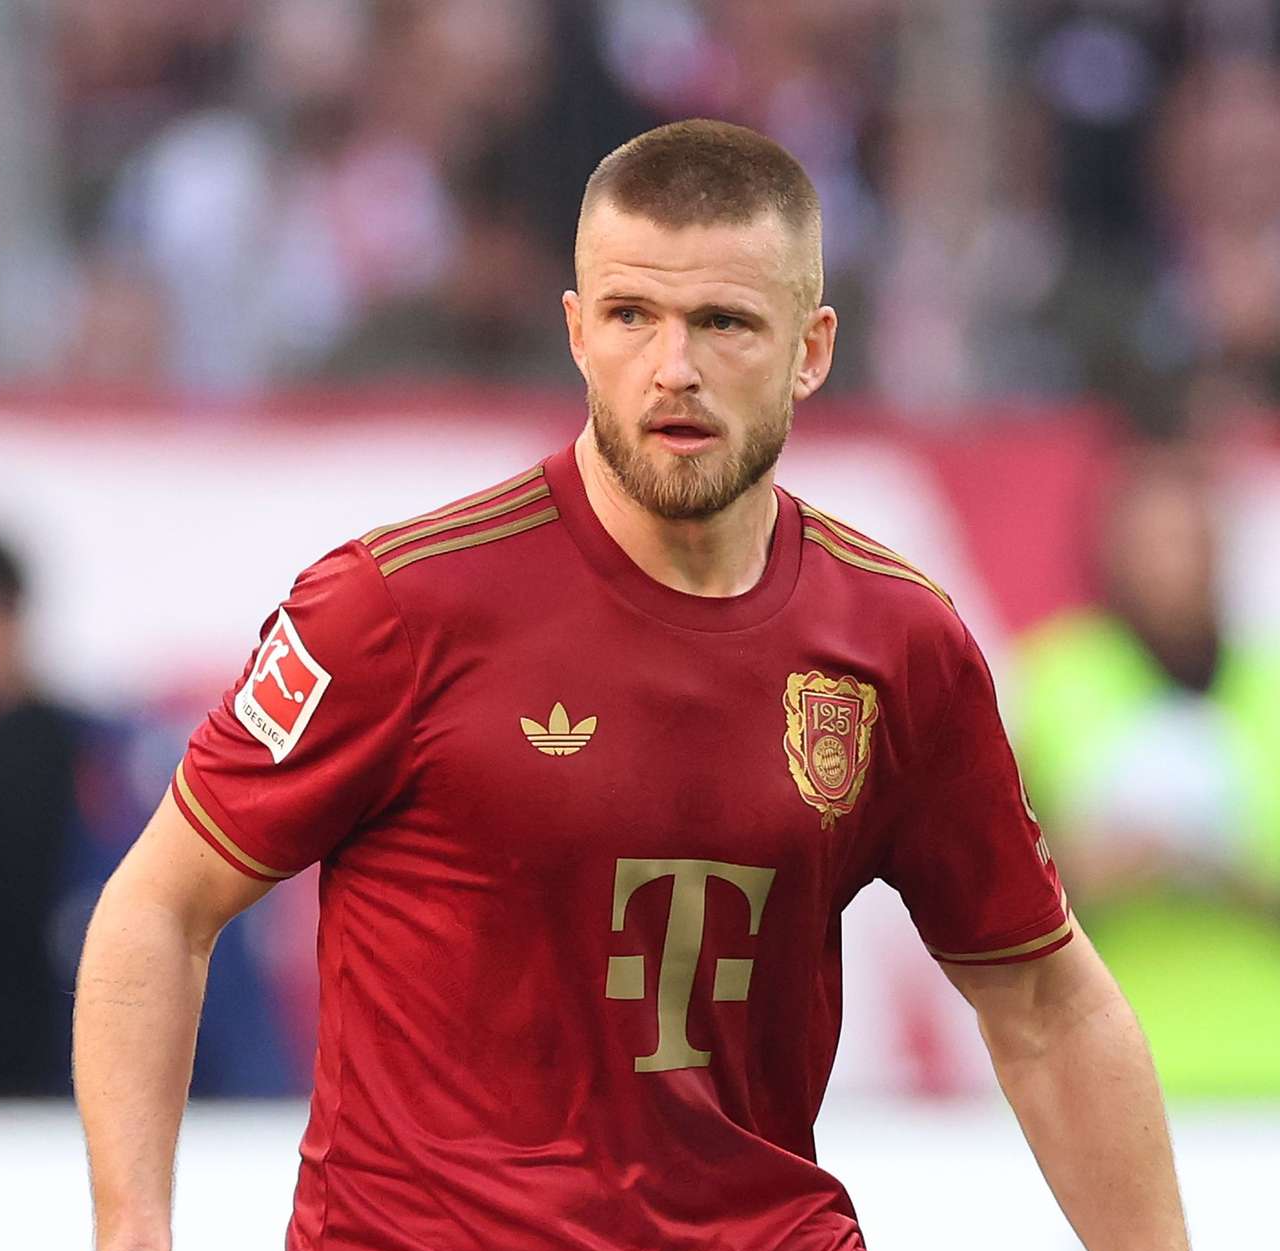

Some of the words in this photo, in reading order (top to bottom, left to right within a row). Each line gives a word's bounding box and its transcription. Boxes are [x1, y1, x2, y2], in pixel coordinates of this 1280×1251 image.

[242, 702, 287, 750] DESLIGA
[811, 702, 851, 736] 125
[606, 858, 777, 1073] T
